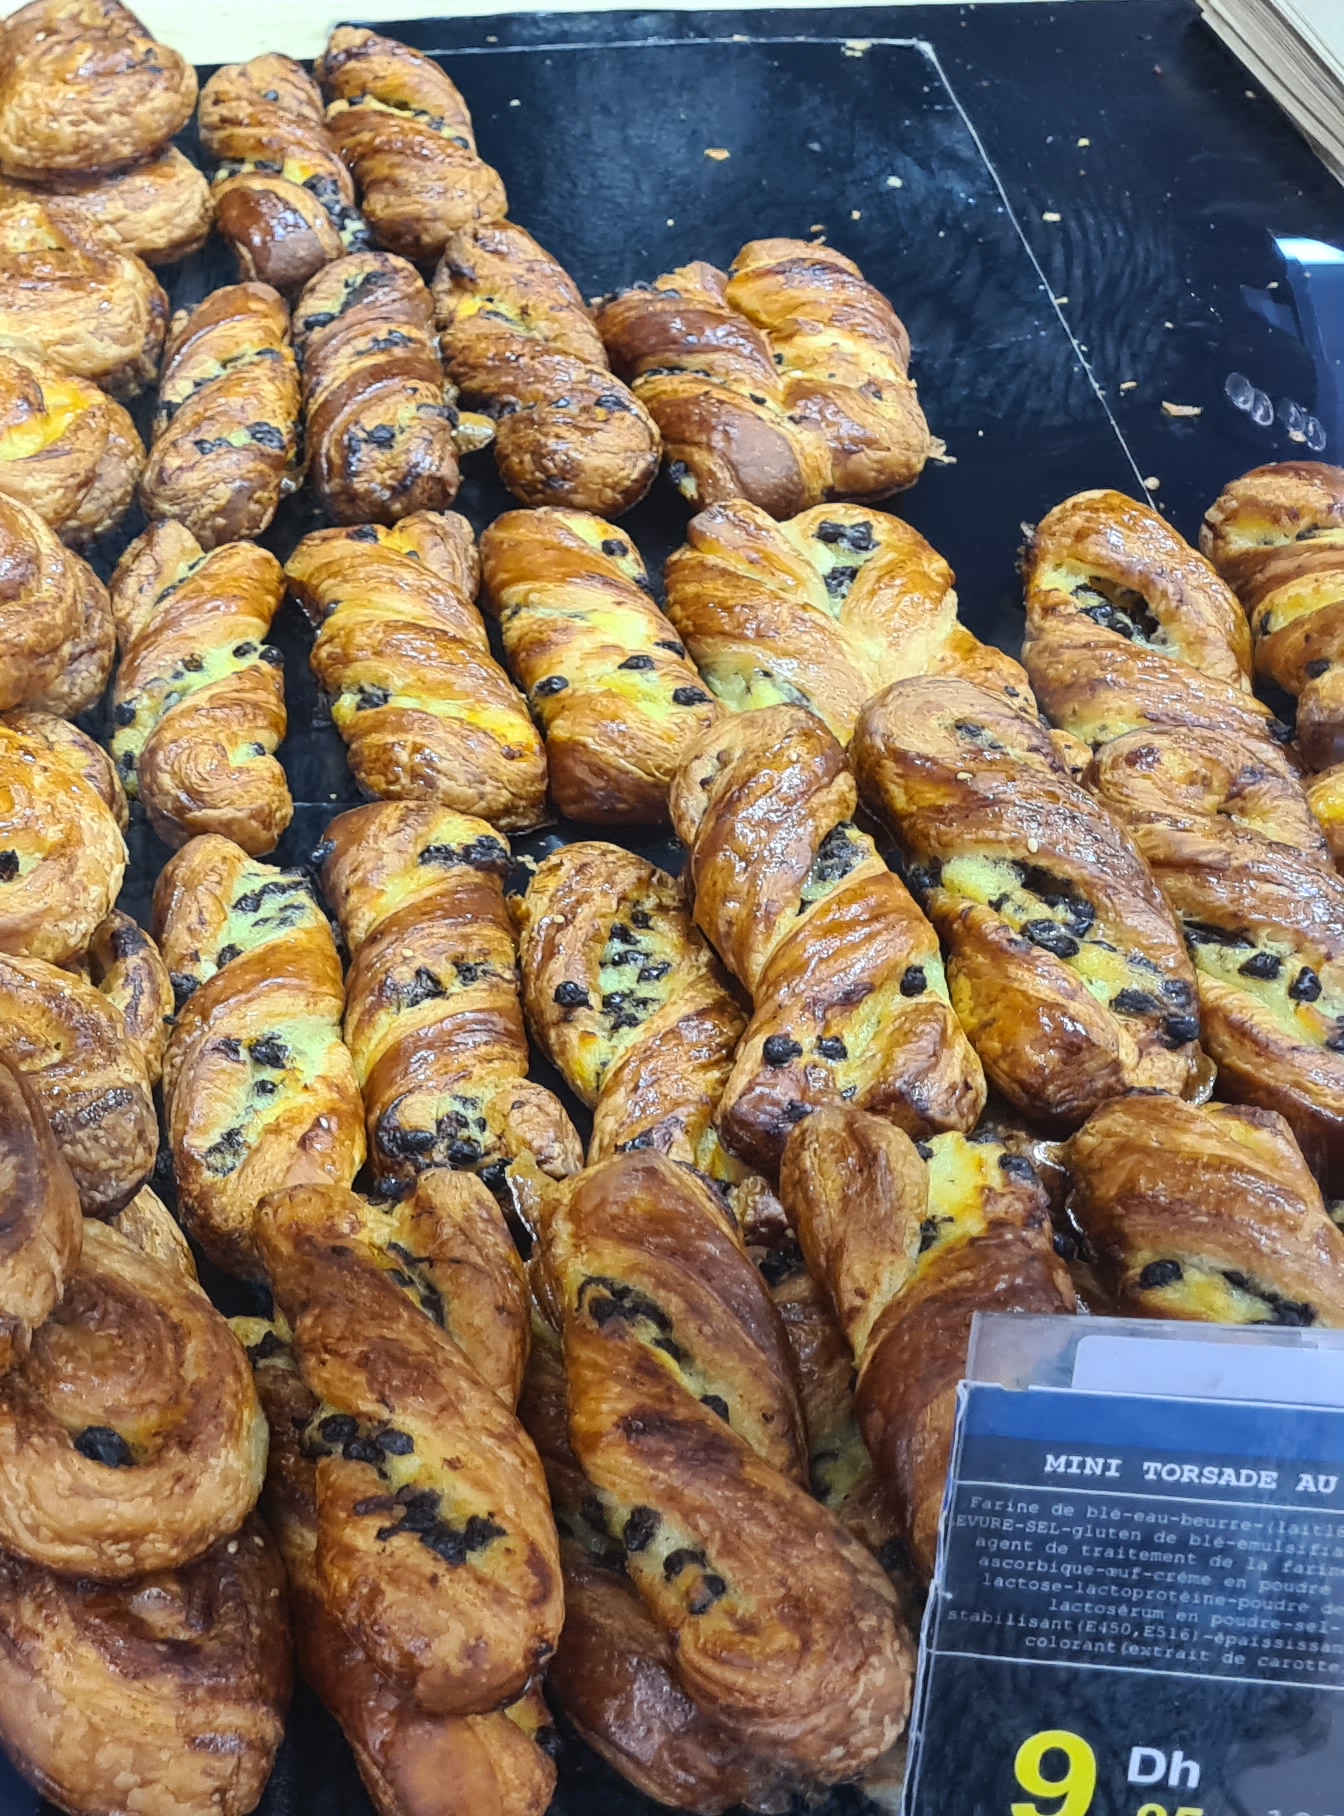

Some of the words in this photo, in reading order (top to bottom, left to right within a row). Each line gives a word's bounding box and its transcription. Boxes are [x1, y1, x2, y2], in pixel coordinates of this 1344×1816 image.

[1044, 1454, 1123, 1478] MINI
[1143, 1461, 1279, 1489] TORSADE
[1295, 1474, 1338, 1493] AU
[970, 1496, 1039, 1514] Farine
[1051, 1502, 1074, 1517] de
[975, 1537, 1033, 1555] agent
[1045, 1542, 1068, 1555] de
[1082, 1545, 1197, 1565] traitement
[1209, 1555, 1233, 1569] de
[1247, 1557, 1268, 1572] la
[1154, 1531, 1176, 1544] de
[983, 1573, 1310, 1612] lactose-lactoprotéine-poudre
[1223, 1577, 1247, 1588] en
[1258, 1581, 1331, 1596] poudre
[1048, 1599, 1164, 1619] lactosérum
[1175, 1611, 1198, 1622] en
[1211, 1613, 1340, 1634] poudre-sel-
[1025, 1636, 1210, 1662] colorant(extrait
[1222, 1651, 1246, 1665] de
[1010, 1730, 1096, 1816] 9
[1127, 1746, 1201, 1789] Dh
